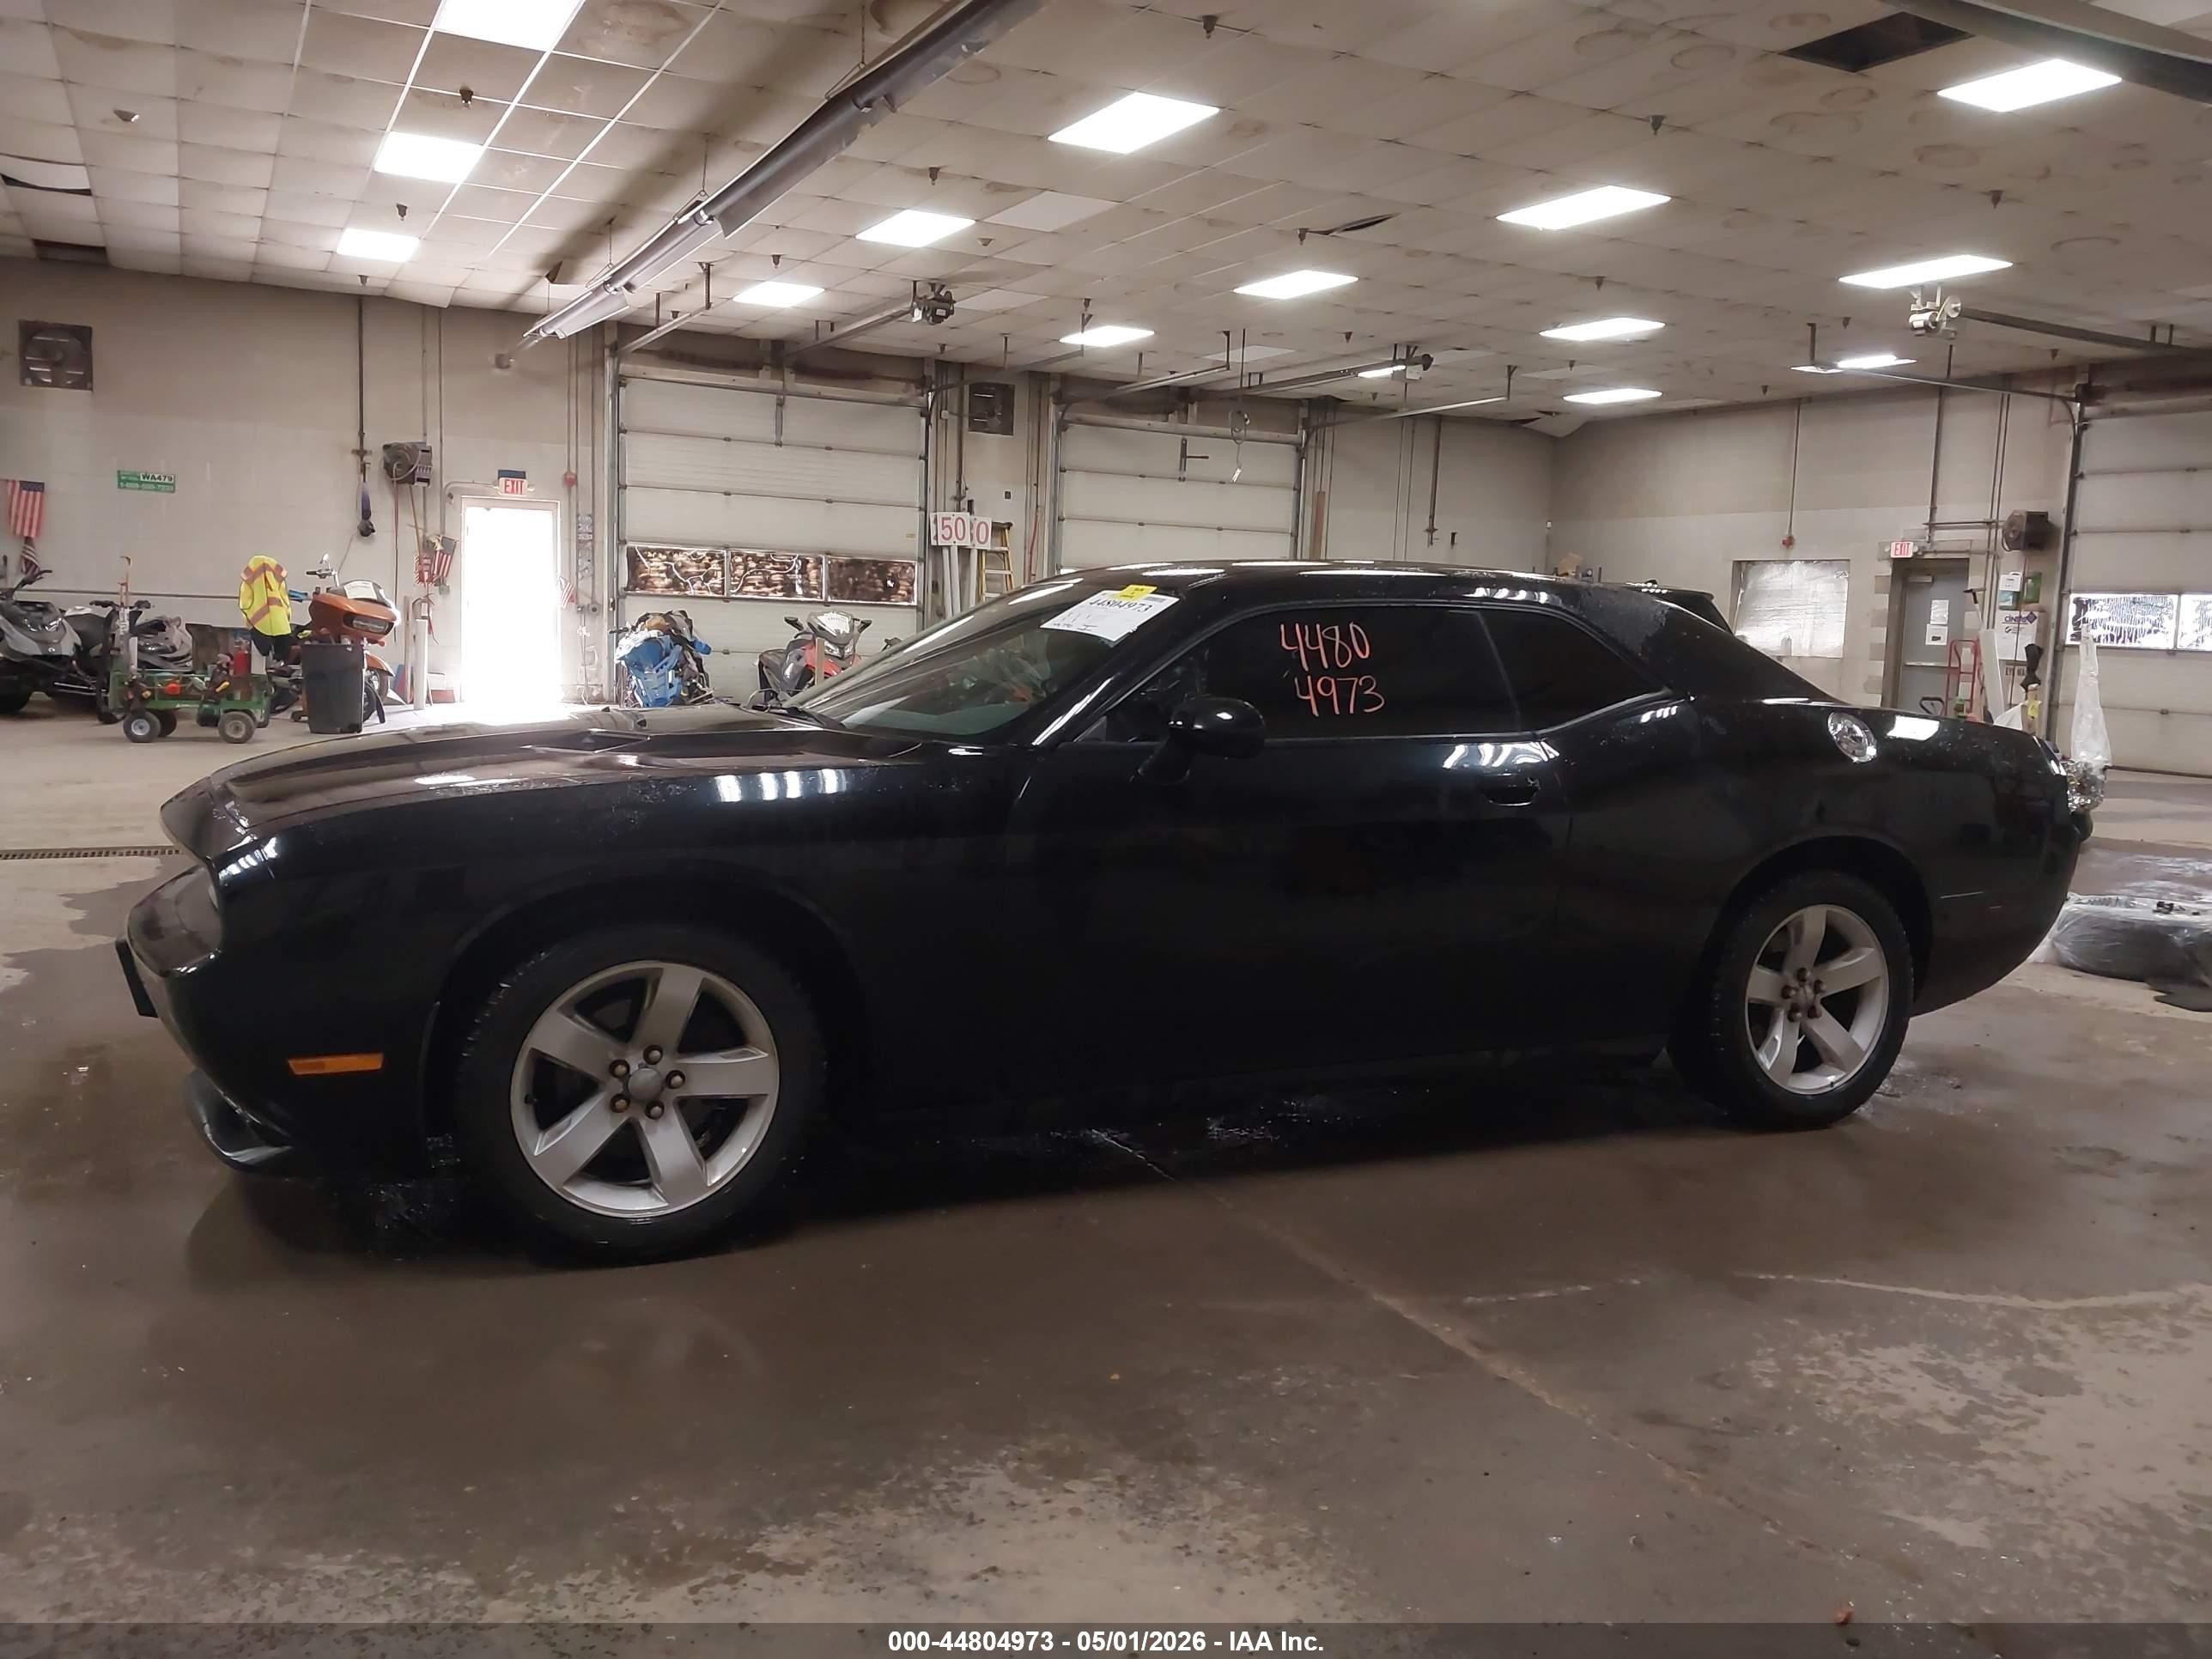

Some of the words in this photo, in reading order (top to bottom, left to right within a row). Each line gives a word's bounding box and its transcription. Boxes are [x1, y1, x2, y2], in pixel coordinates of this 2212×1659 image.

[504, 478, 524, 495] EXIT
[941, 517, 966, 541] 50
[1894, 542, 1911, 556] EXIT
[1280, 622, 1370, 672] 4480
[1294, 675, 1385, 717] 4973
